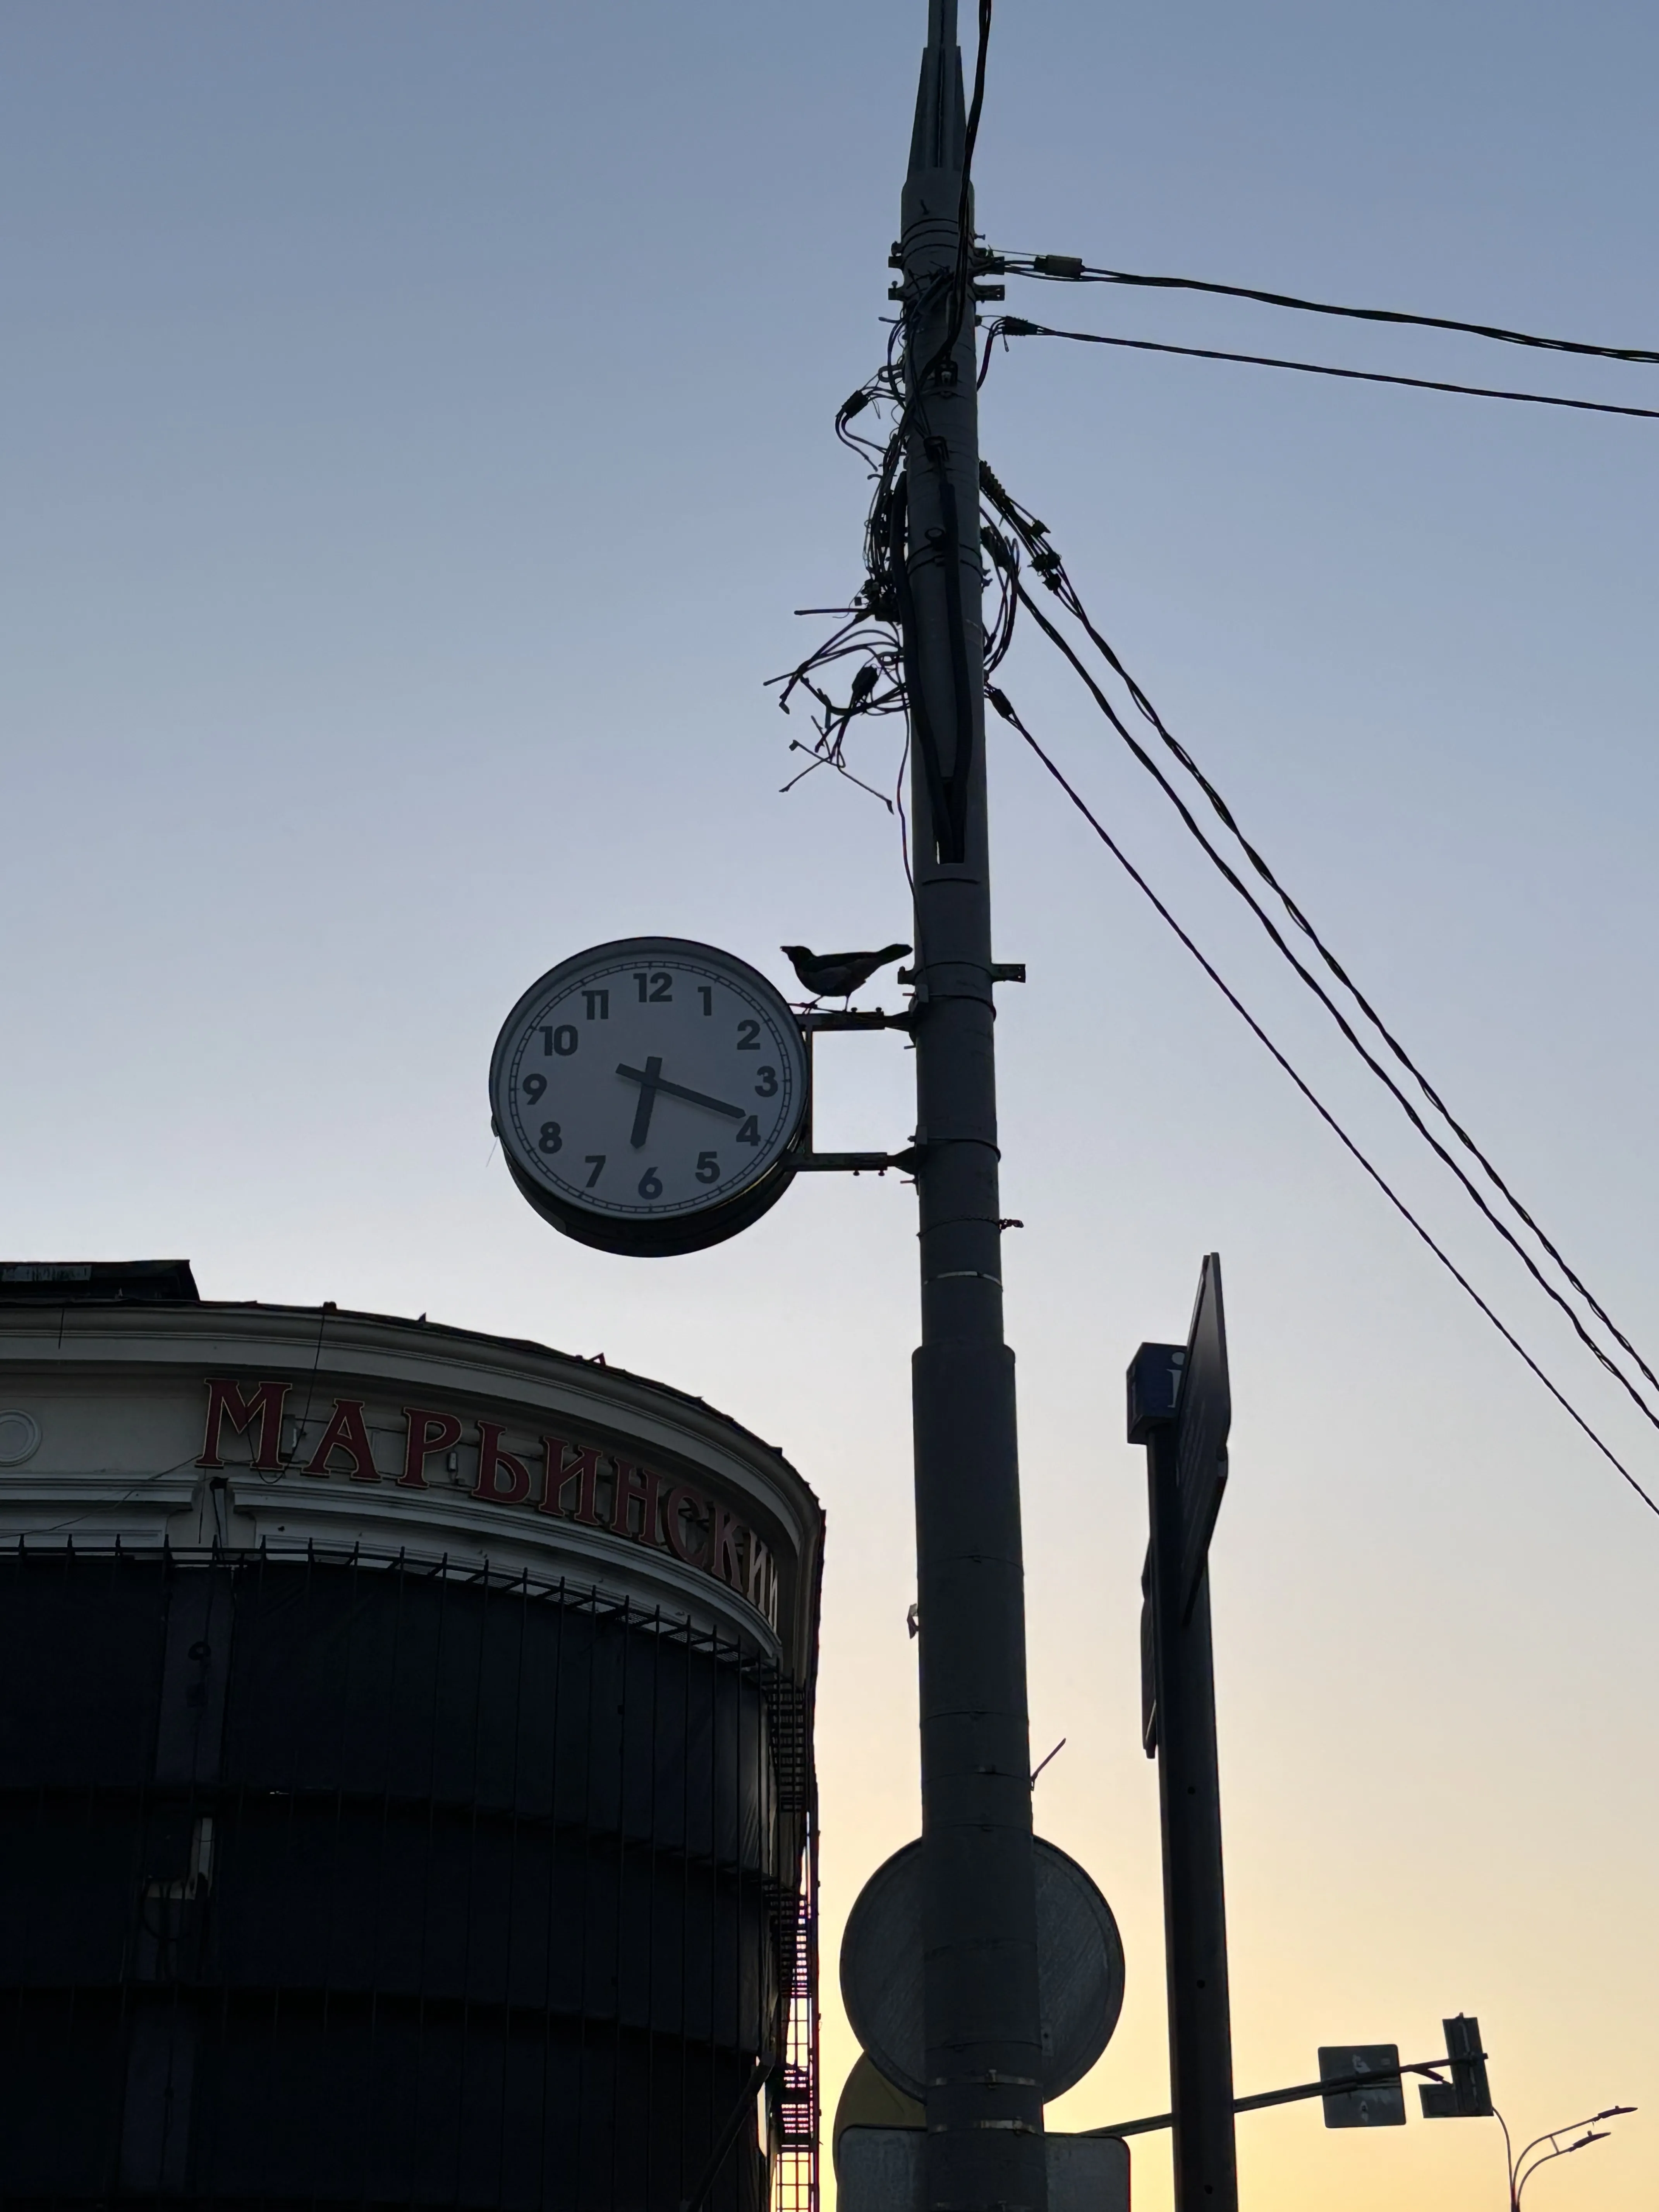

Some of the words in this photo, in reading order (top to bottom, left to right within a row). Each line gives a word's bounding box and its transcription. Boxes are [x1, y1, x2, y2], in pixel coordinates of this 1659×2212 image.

[633, 972, 673, 1003] 12
[698, 986, 712, 1016] 1
[582, 990, 609, 1020] 11
[539, 1025, 578, 1056] 10
[737, 1020, 760, 1050] 2
[522, 1073, 547, 1105] 9
[755, 1066, 778, 1097] 3
[539, 1121, 562, 1154] 8
[736, 1116, 761, 1146] 4
[585, 1155, 606, 1188] 7
[696, 1151, 720, 1183] 5
[638, 1167, 663, 1200] 6
